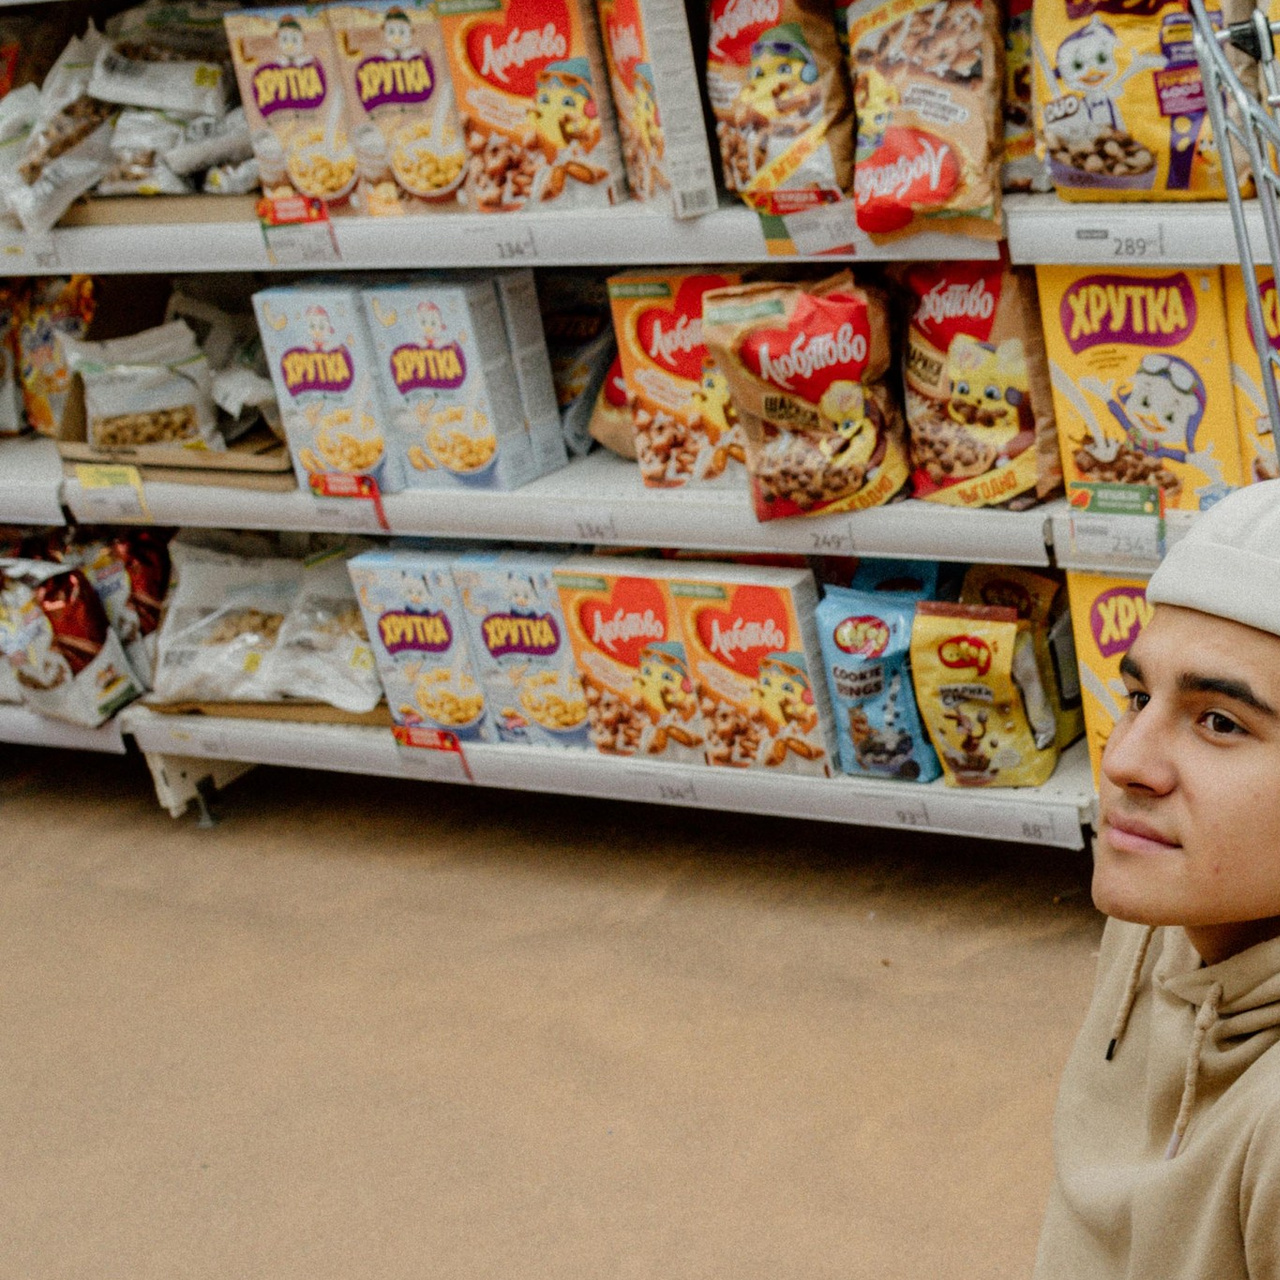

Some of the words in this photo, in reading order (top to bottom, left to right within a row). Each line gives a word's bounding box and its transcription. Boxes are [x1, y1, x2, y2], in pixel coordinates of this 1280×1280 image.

[1113, 235, 1147, 255] 289
[1067, 284, 1188, 341] ХРУТКА
[759, 322, 867, 391] Любятово
[1098, 596, 1156, 648] ХРУ
